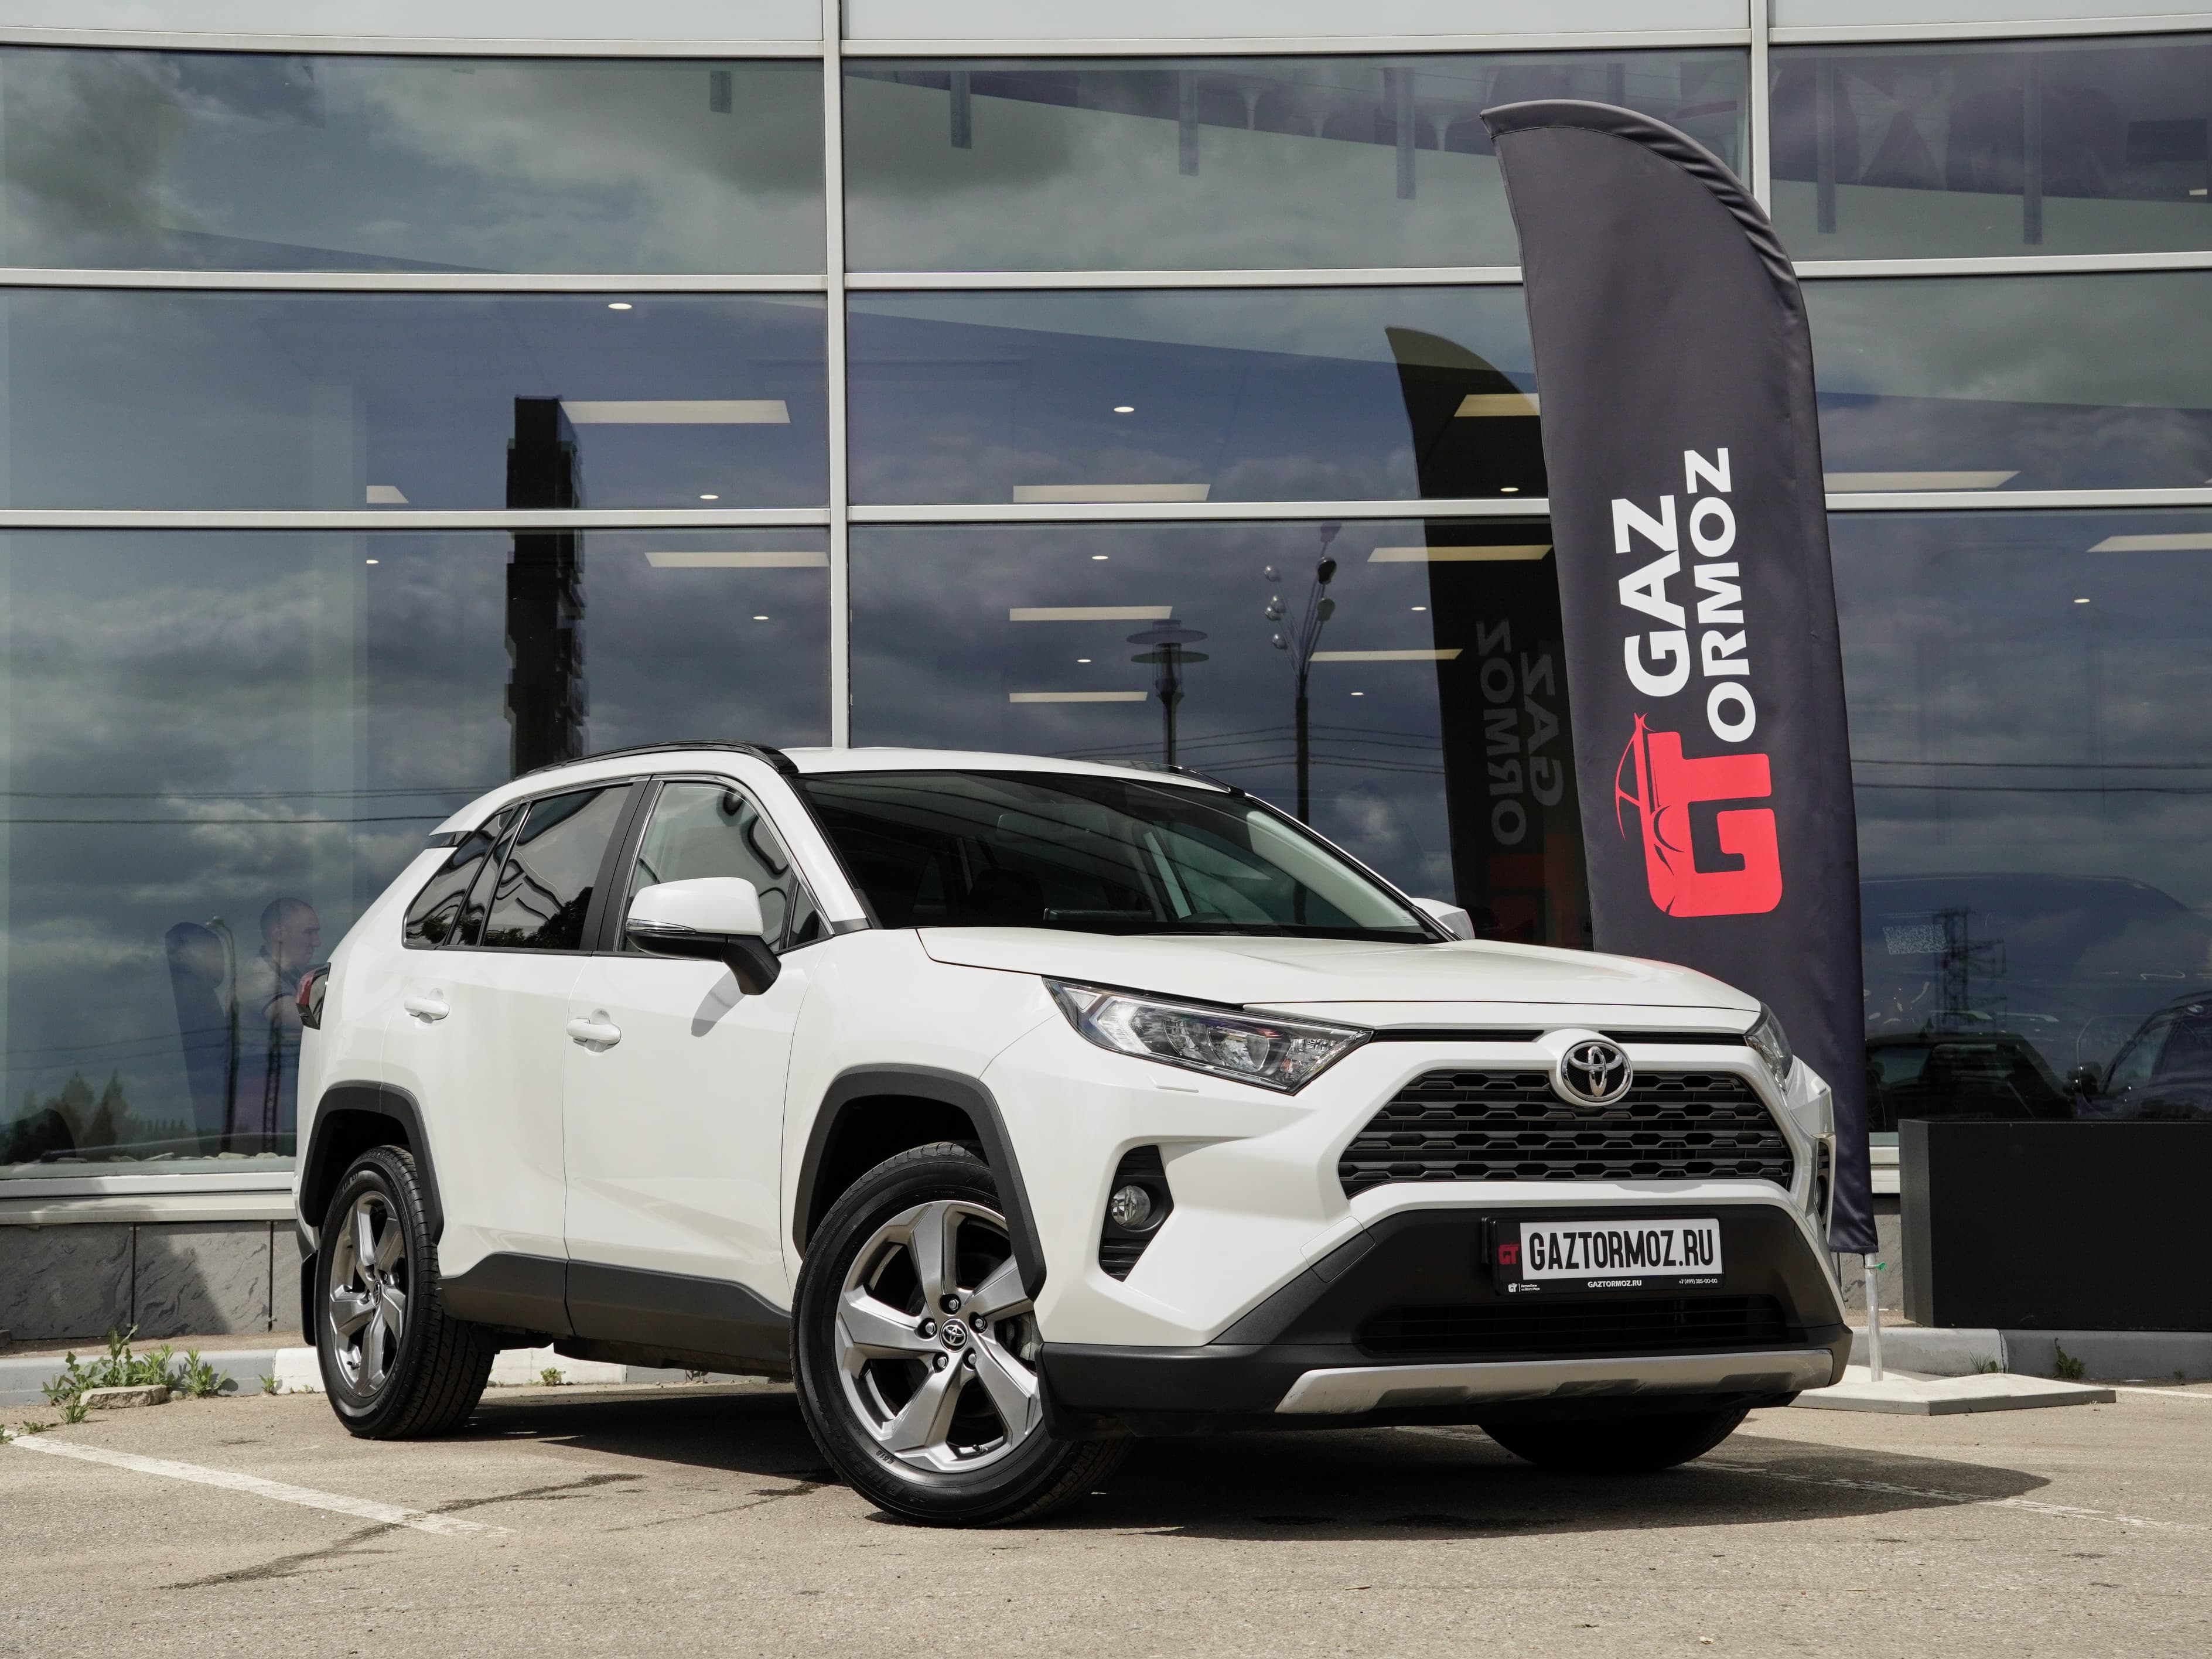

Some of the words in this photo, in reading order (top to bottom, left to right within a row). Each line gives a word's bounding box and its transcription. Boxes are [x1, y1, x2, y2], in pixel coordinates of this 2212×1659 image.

[1612, 495, 1690, 697] GAZ
[1684, 448, 1757, 742] ORMOZ
[1529, 1229, 1713, 1271] GAZTORMOZ.RU
[1587, 1279, 1642, 1288] GAZTORMOZ.RU
